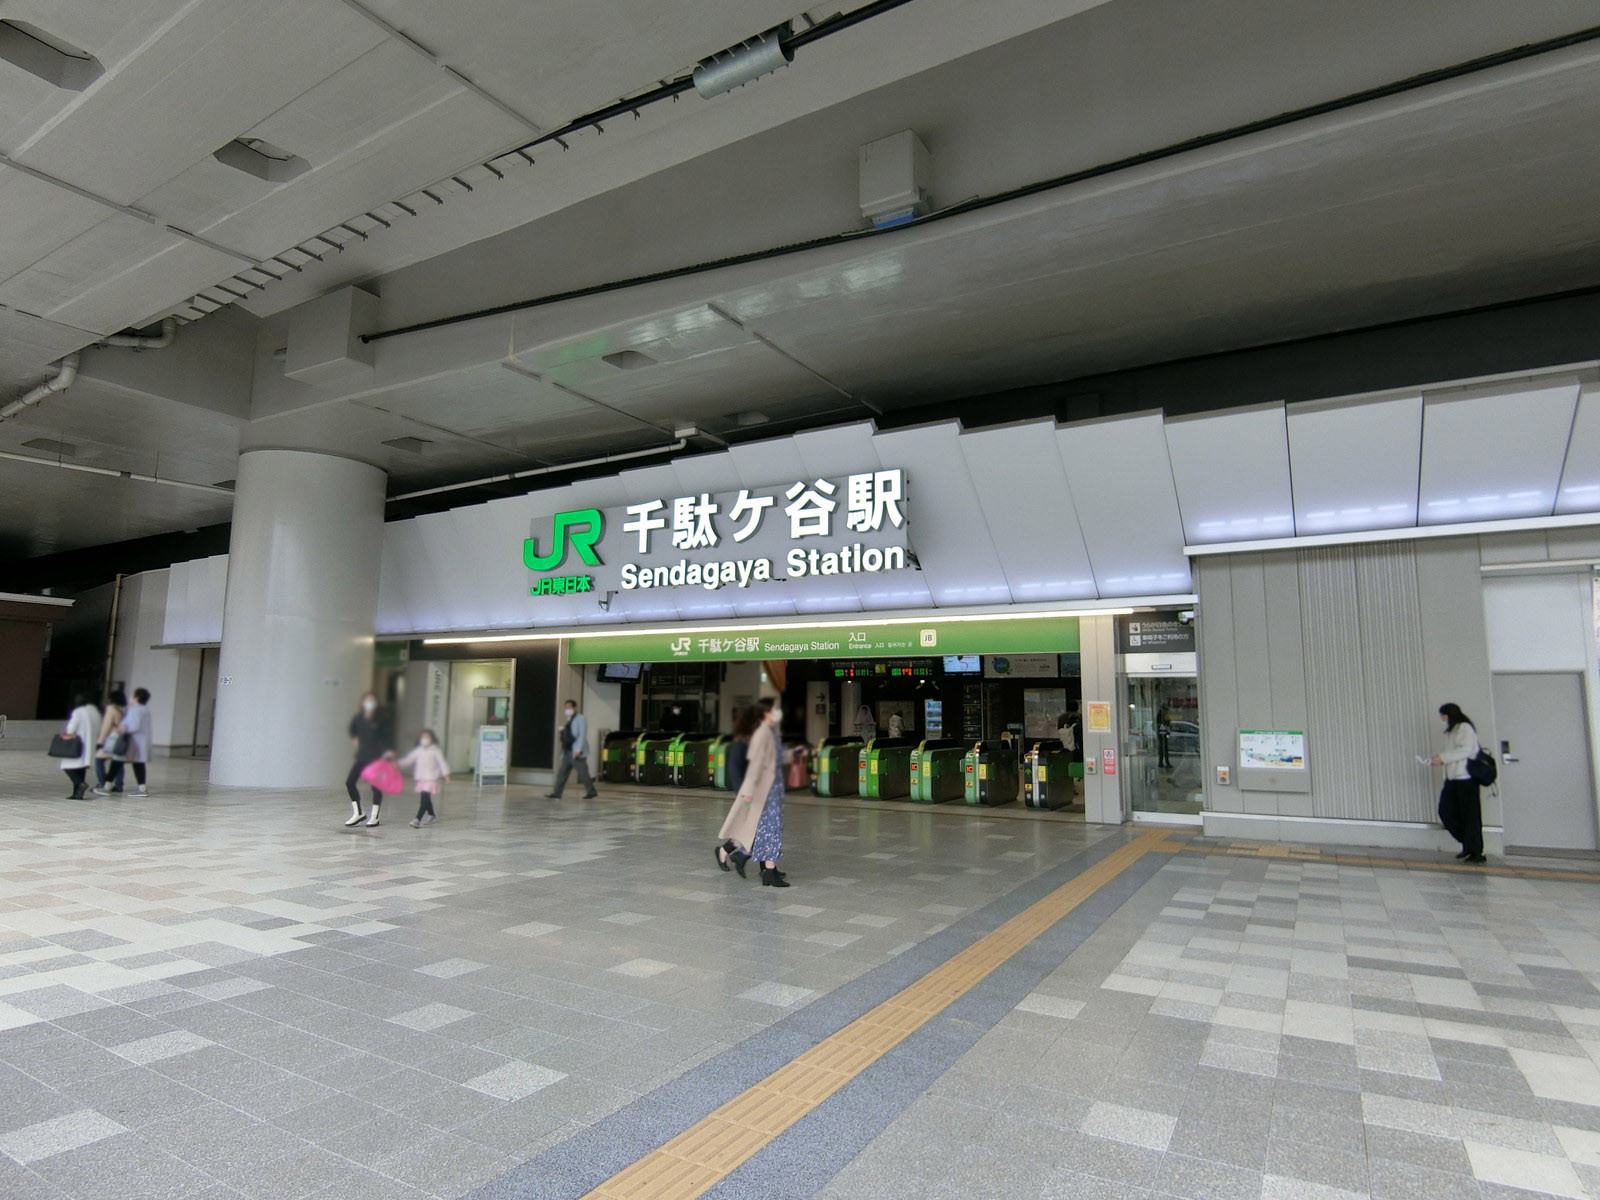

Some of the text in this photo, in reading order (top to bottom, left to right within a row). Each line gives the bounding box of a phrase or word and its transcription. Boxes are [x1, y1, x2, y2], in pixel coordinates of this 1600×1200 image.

[623, 469, 904, 554] 千駄ケ谷駅
[523, 508, 602, 571] JR
[621, 543, 904, 590] Sendagaya Station
[530, 575, 592, 596] JR東日本
[671, 637, 691, 651] JR
[698, 637, 760, 653] 千駄ケ谷駅
[848, 632, 866, 642] 入口
[924, 634, 933, 642] JB
[764, 641, 840, 653] Sendagaya Station
